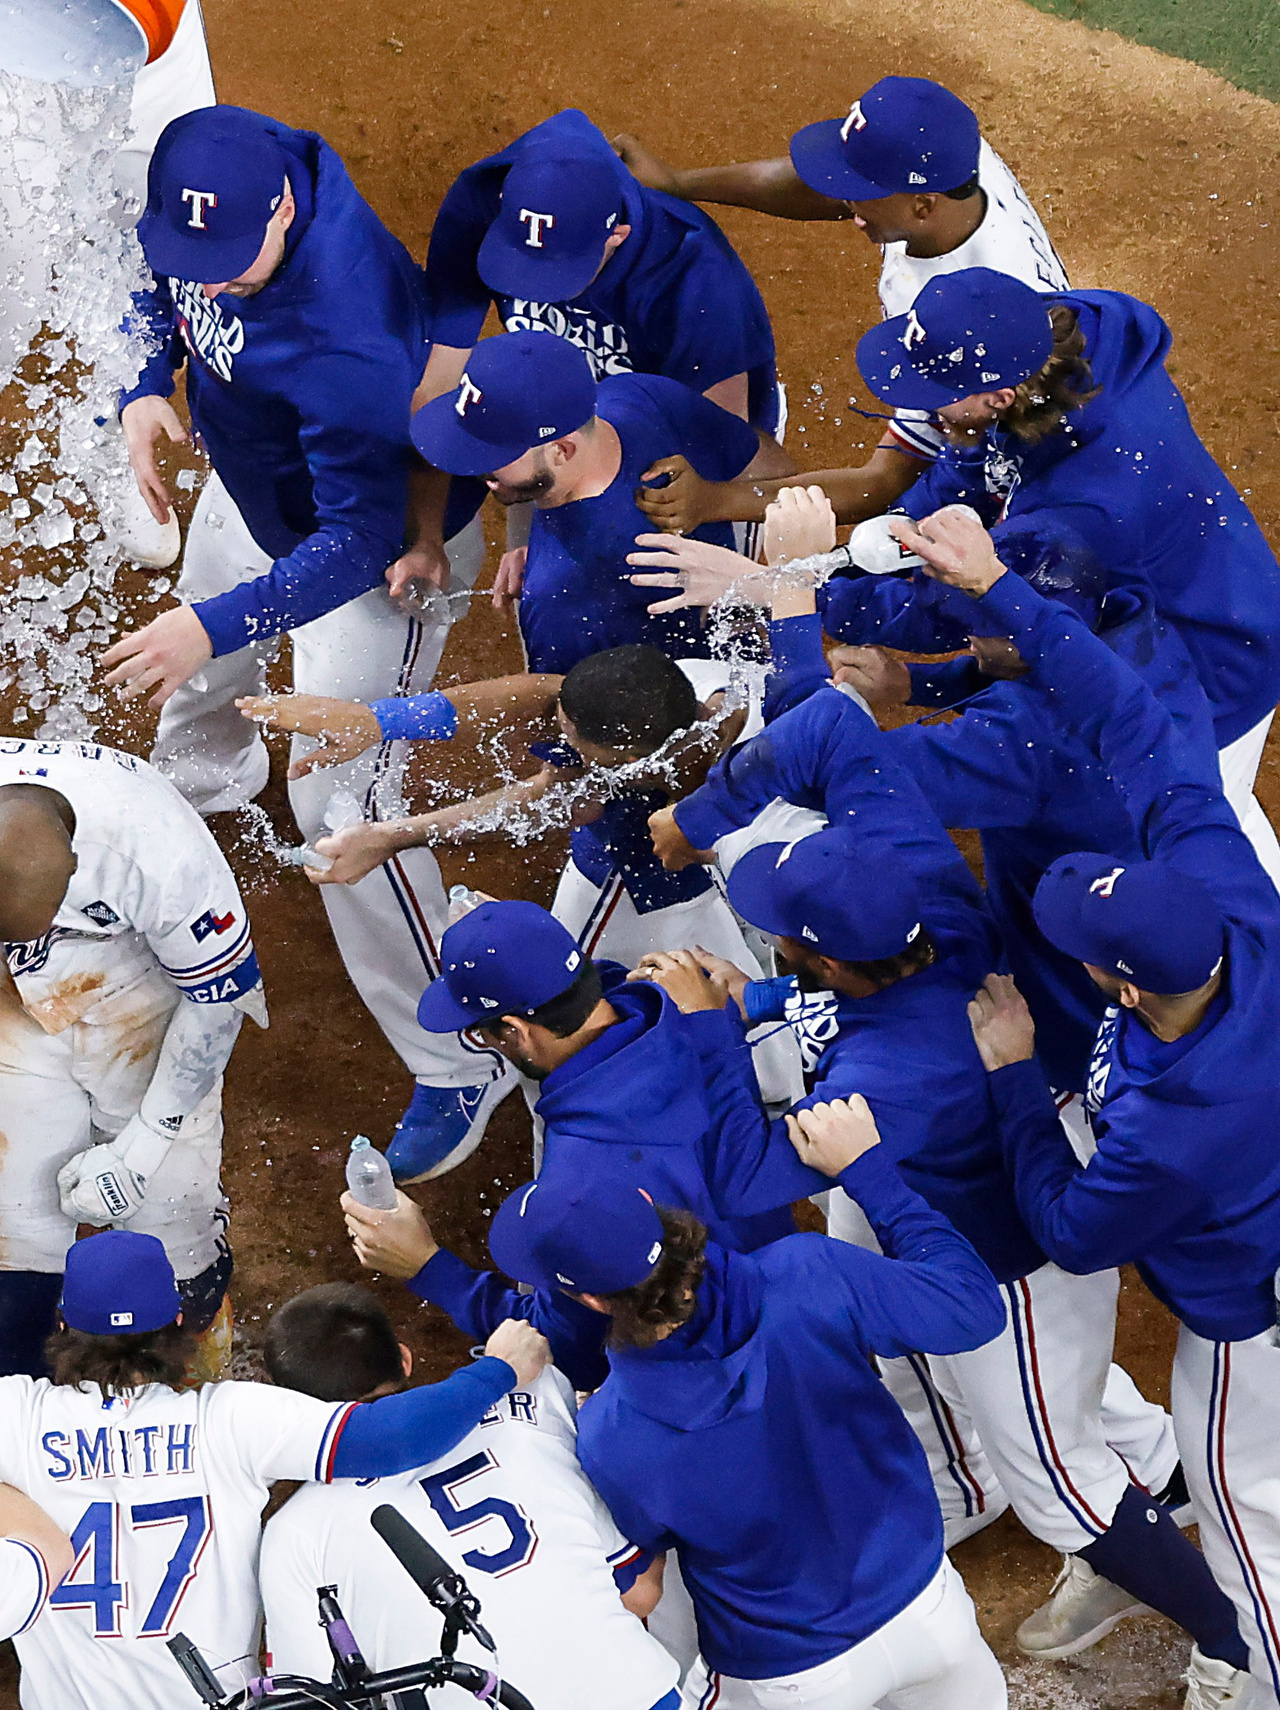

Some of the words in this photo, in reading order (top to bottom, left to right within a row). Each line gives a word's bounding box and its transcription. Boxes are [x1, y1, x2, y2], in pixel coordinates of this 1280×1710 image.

[840, 100, 867, 143] T
[182, 188, 218, 231] T
[520, 208, 556, 248] T
[181, 279, 245, 355] ORLD
[903, 308, 926, 350] T
[455, 373, 483, 418] T
[102, 1176, 127, 1211] Franklin
[42, 1424, 197, 1482] SMITH
[419, 1448, 539, 1579] 5
[49, 1495, 214, 1639] 47
